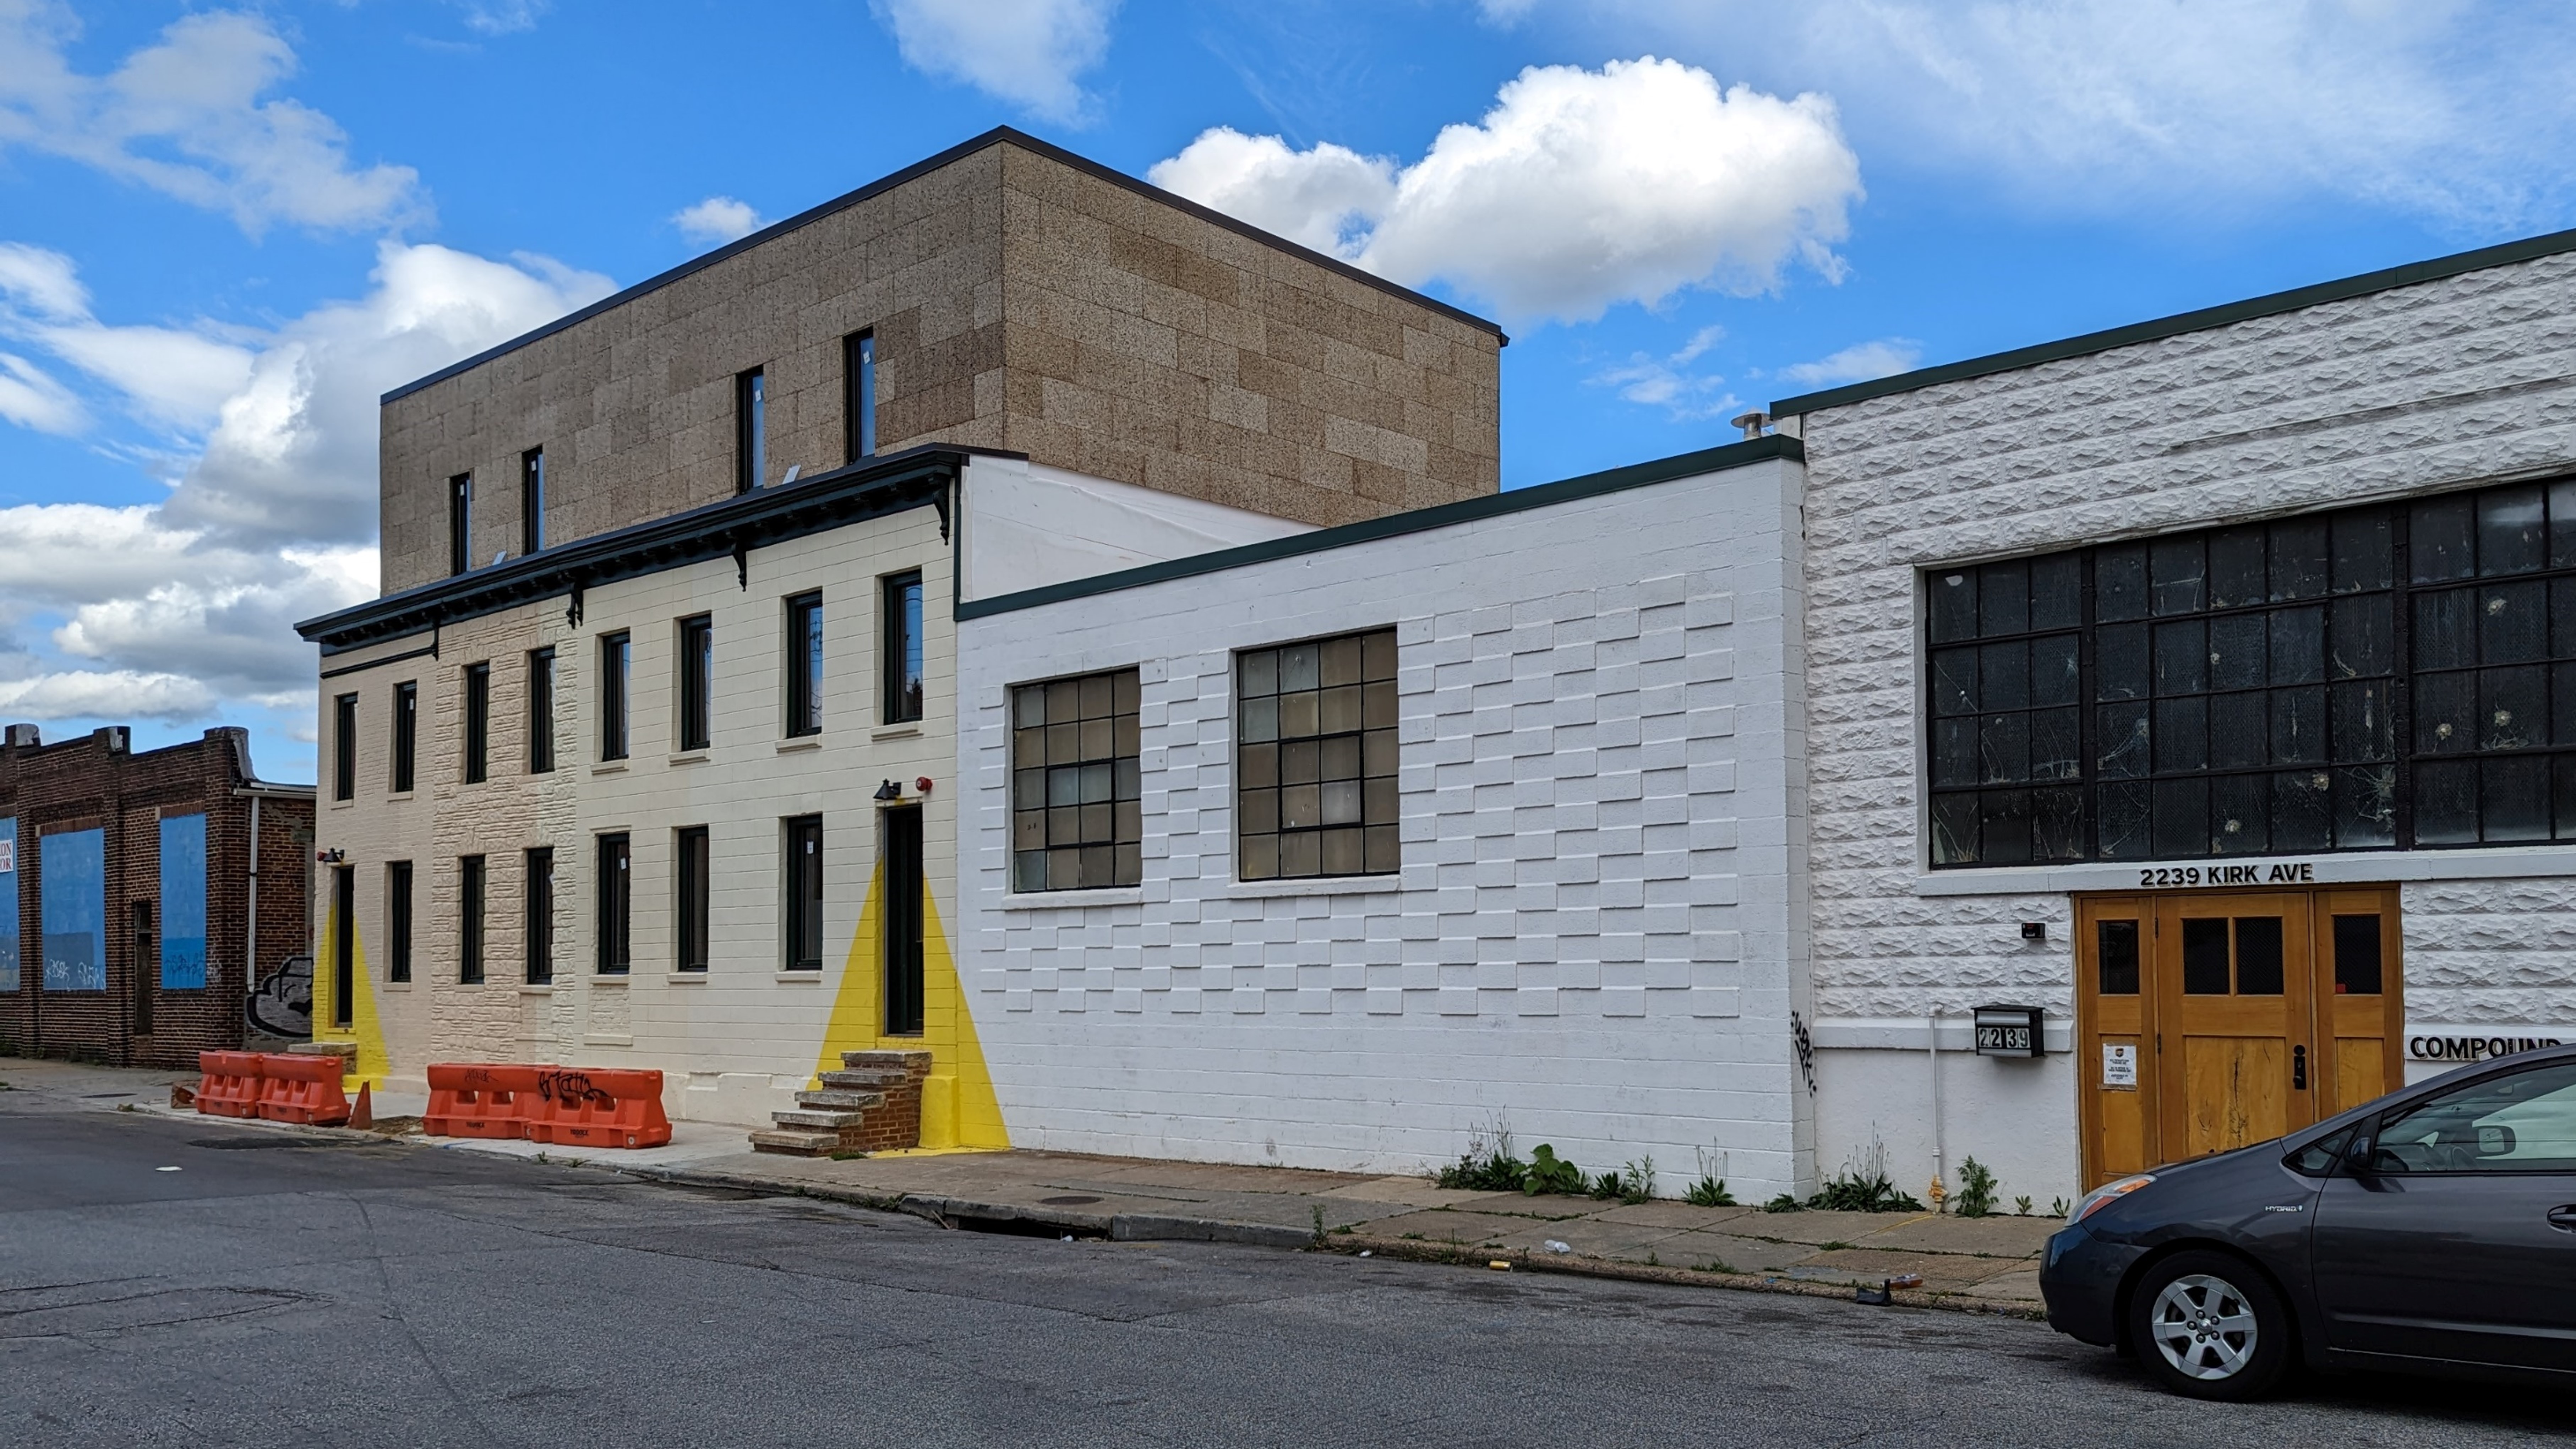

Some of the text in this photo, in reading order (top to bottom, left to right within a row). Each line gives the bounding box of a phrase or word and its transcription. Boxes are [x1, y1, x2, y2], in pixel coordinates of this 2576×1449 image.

[0, 843, 11, 856] ON
[0, 858, 11, 870] OR
[2140, 863, 2314, 886] 2239 KIRK AVE
[1979, 1028, 2029, 1047] 2239
